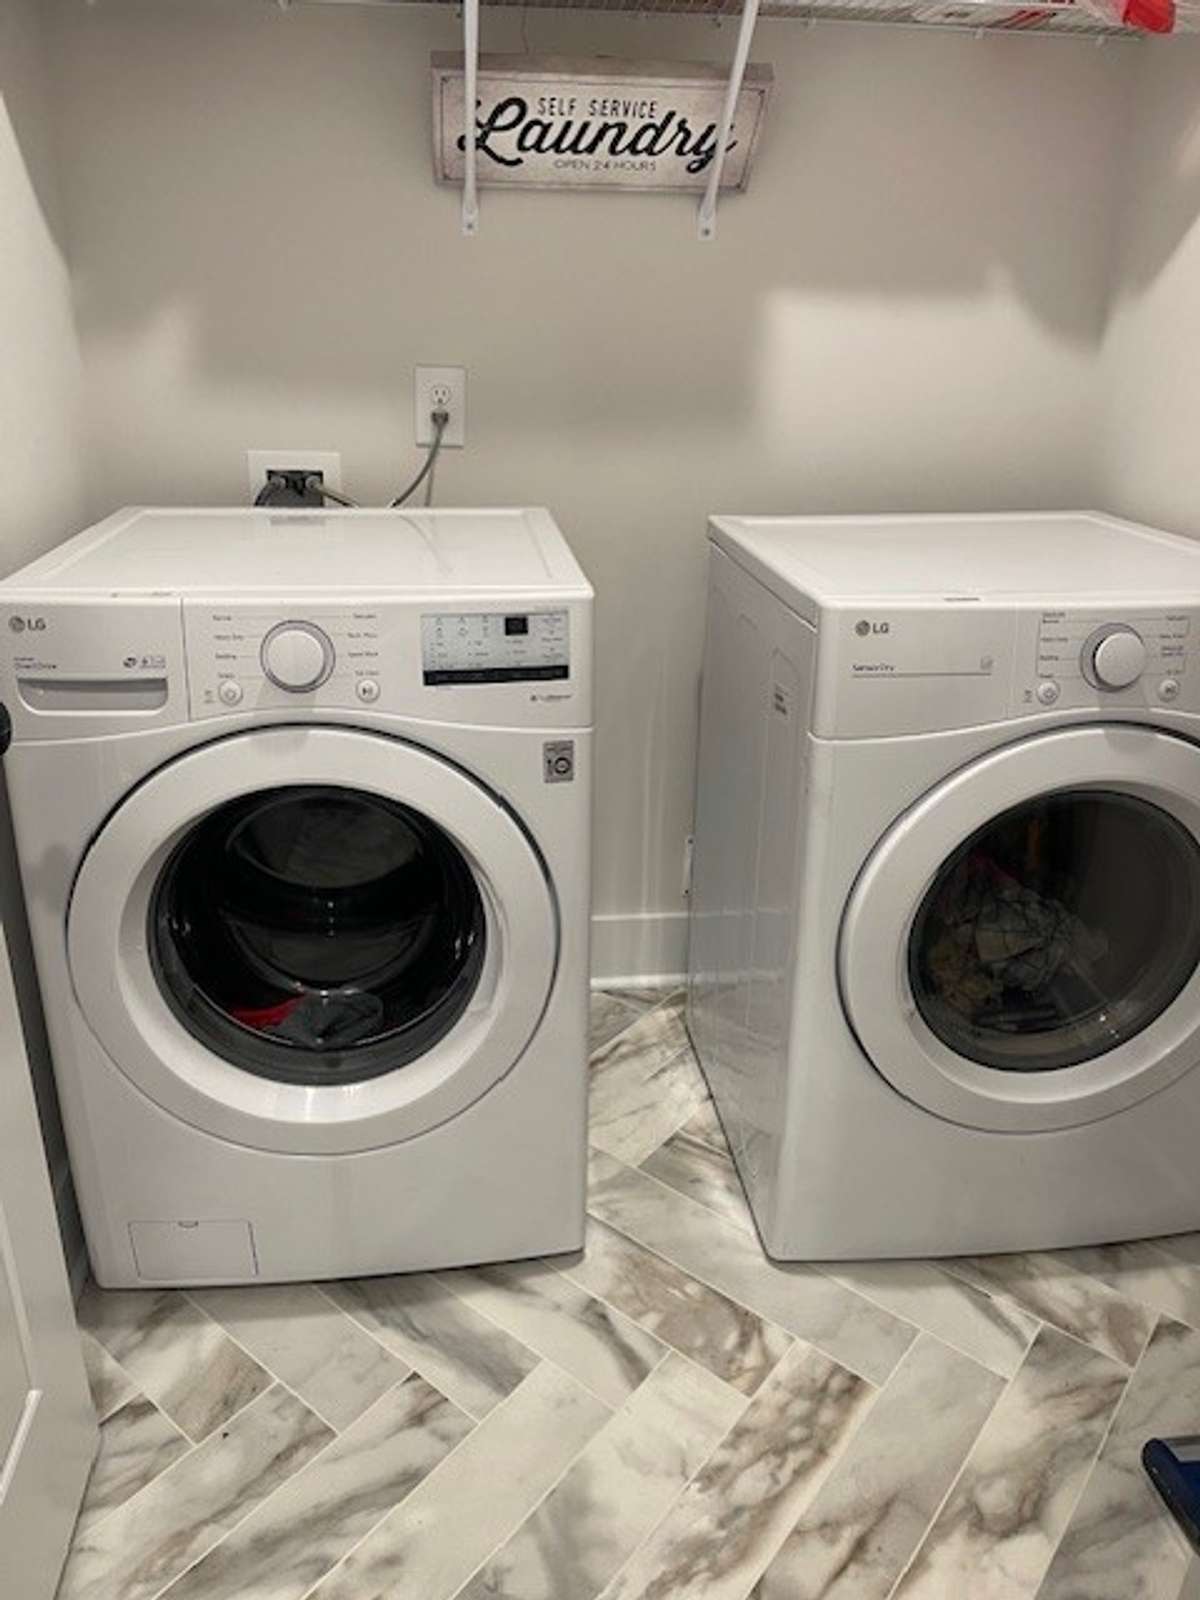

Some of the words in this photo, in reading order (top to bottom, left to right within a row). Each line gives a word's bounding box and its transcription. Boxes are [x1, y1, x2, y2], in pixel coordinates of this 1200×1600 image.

[537, 97, 577, 117] SELF
[588, 98, 659, 120] SERVICE
[457, 96, 738, 174] Laundry
[554, 159, 591, 170] OPEN
[592, 160, 610, 171] 24
[613, 160, 657, 171] HOURS
[27, 618, 47, 631] LG
[872, 622, 889, 634] LG
